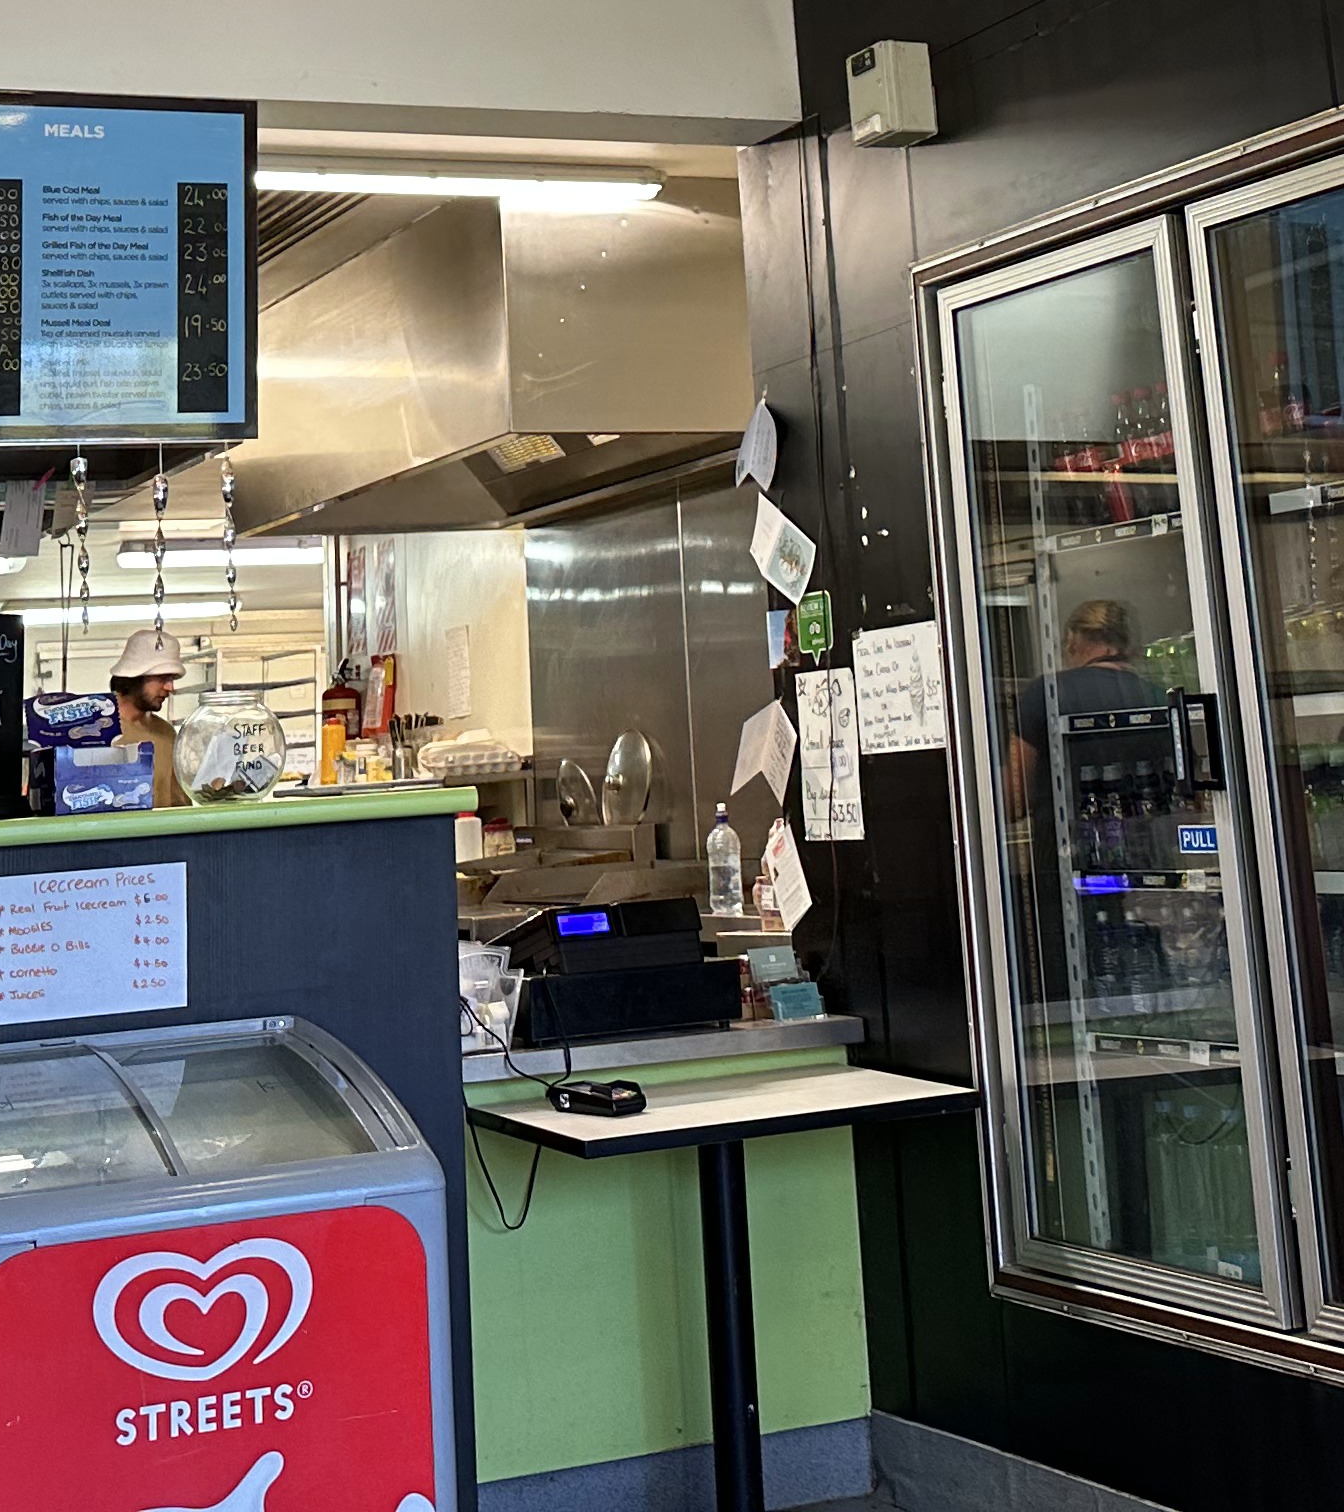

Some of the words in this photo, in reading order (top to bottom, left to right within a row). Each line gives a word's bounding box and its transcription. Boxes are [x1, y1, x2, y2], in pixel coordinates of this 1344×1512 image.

[44, 124, 105, 138] MEALS
[0, 634, 18, 663] Day
[232, 723, 266, 739] STAFF
[234, 743, 264, 755] BEER
[236, 761, 262, 772] FUND
[1183, 829, 1215, 850] PULL
[33, 878, 109, 894] Icecream
[116, 872, 155, 887] Prices
[10, 904, 35, 914] Real
[44, 901, 69, 911] Fruit
[76, 900, 127, 910] Icecream
[66, 941, 90, 950] Bills
[115, 1386, 297, 1448] STREETS
